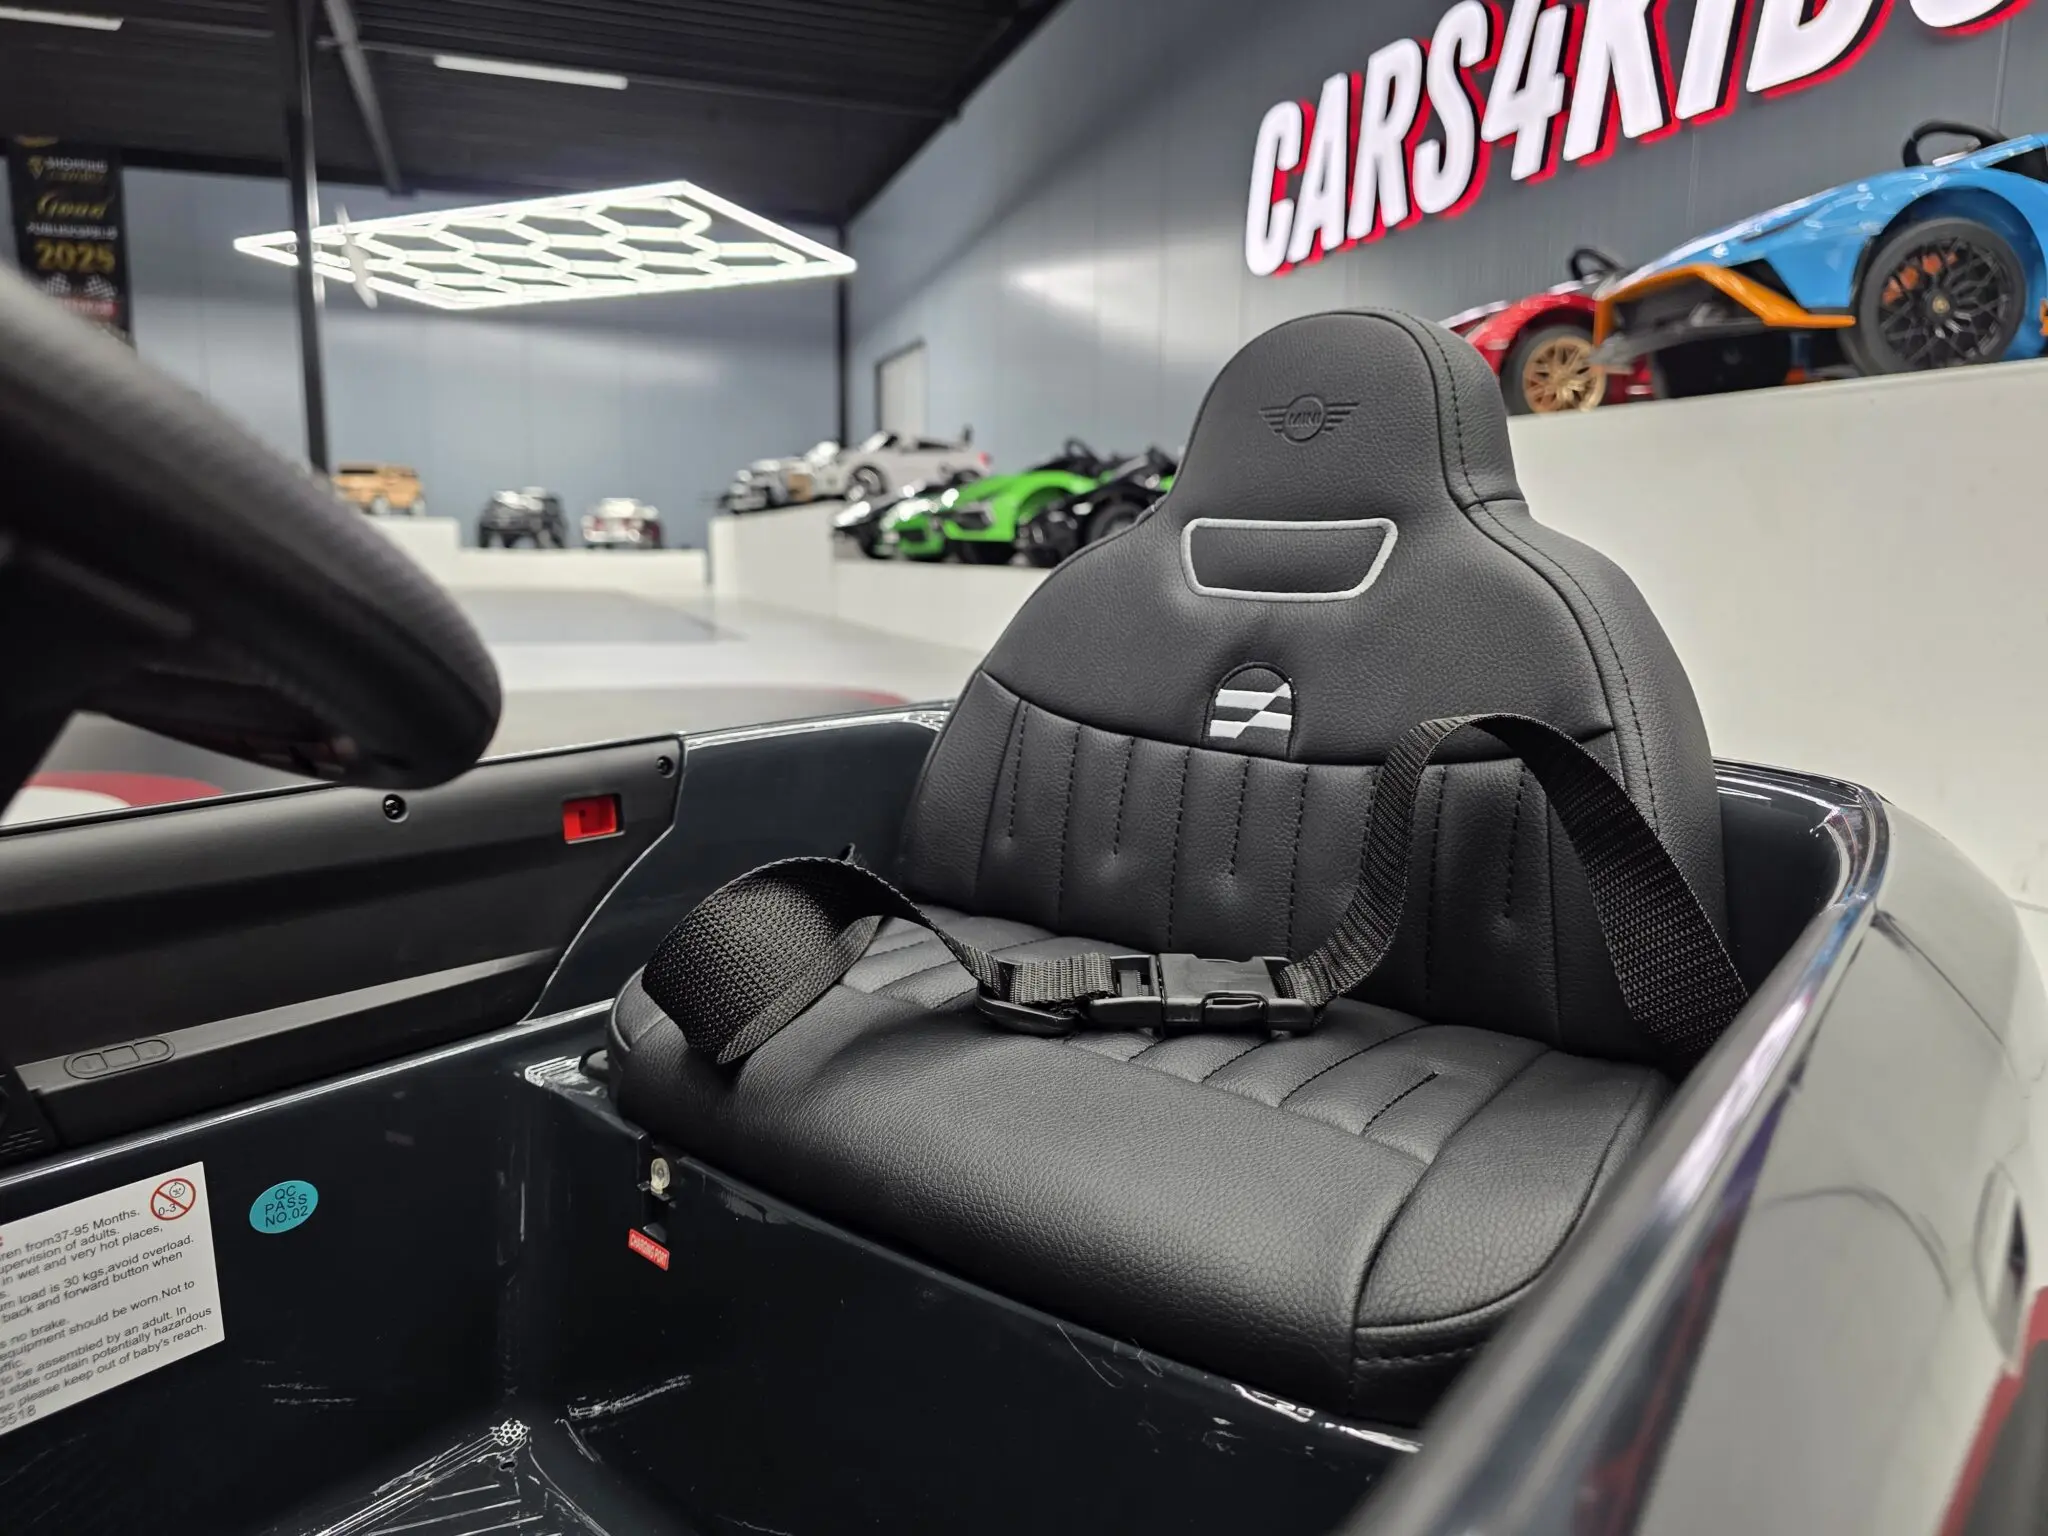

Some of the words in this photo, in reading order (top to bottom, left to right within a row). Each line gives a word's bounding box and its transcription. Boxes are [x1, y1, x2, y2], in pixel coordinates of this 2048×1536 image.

[1246, 0, 2002, 276] CARS4K
[34, 239, 116, 273] 2025
[158, 1203, 177, 1217] 0-3
[264, 1193, 308, 1216] PASS
[274, 1185, 297, 1201] QC
[93, 1209, 140, 1230] Months.
[265, 1205, 309, 1228] NO.02
[18, 1265, 40, 1280] wet
[43, 1256, 67, 1272] and
[71, 1247, 97, 1262] very
[100, 1238, 119, 1252] hot
[122, 1225, 163, 1247] places,
[65, 1239, 77, 1251] of
[2, 1305, 33, 1323] back
[37, 1294, 60, 1311] and
[63, 1276, 109, 1301] forward
[112, 1262, 149, 1283] button
[152, 1250, 183, 1268] when
[18, 1287, 46, 1305] load
[49, 1283, 60, 1294] is
[63, 1275, 79, 1289] 30
[142, 1234, 195, 1260] overload.
[69, 1311, 109, 1335] should
[112, 1306, 127, 1319] be
[184, 1280, 195, 1290] to
[9, 1376, 41, 1396] state
[43, 1357, 89, 1381] contain
[92, 1331, 151, 1364] potentially
[154, 1307, 212, 1337] hazardous
[10, 1333, 27, 1345] no
[15, 1367, 33, 1380] be
[37, 1337, 103, 1372] assembled
[106, 1332, 121, 1346] by
[124, 1325, 139, 1338] an
[142, 1311, 173, 1331] adult.
[176, 1305, 187, 1317] In
[18, 1383, 60, 1409] please
[63, 1369, 94, 1388] keep
[97, 1358, 117, 1374] out
[119, 1352, 131, 1365] of
[133, 1337, 170, 1360] baby's
[173, 1324, 208, 1343] reach.
